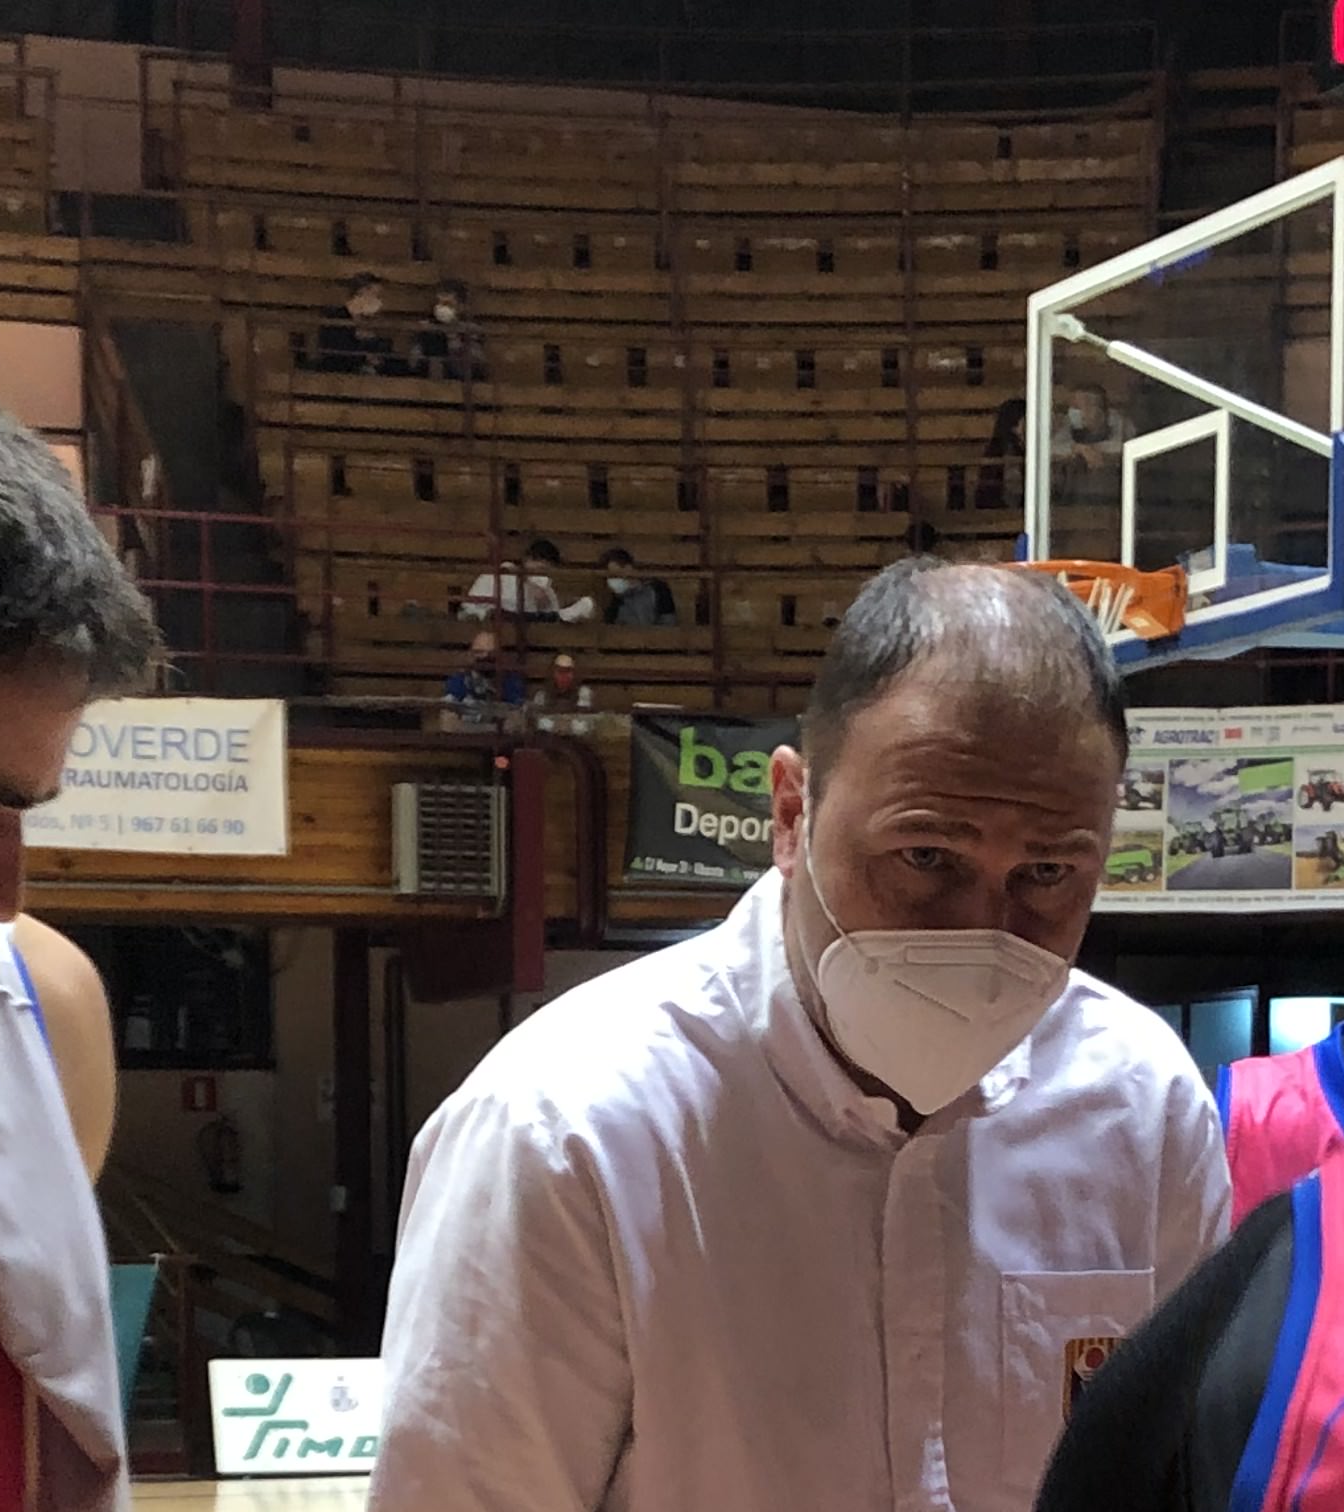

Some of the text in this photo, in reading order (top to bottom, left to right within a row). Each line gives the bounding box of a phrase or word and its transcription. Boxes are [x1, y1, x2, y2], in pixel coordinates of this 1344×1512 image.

[69, 721, 250, 764] OVERDE
[61, 766, 249, 793] RAUMATOLOGÍA
[132, 815, 164, 833] 967
[171, 816, 192, 834] 61
[196, 817, 219, 835] 66
[223, 818, 246, 836] 90
